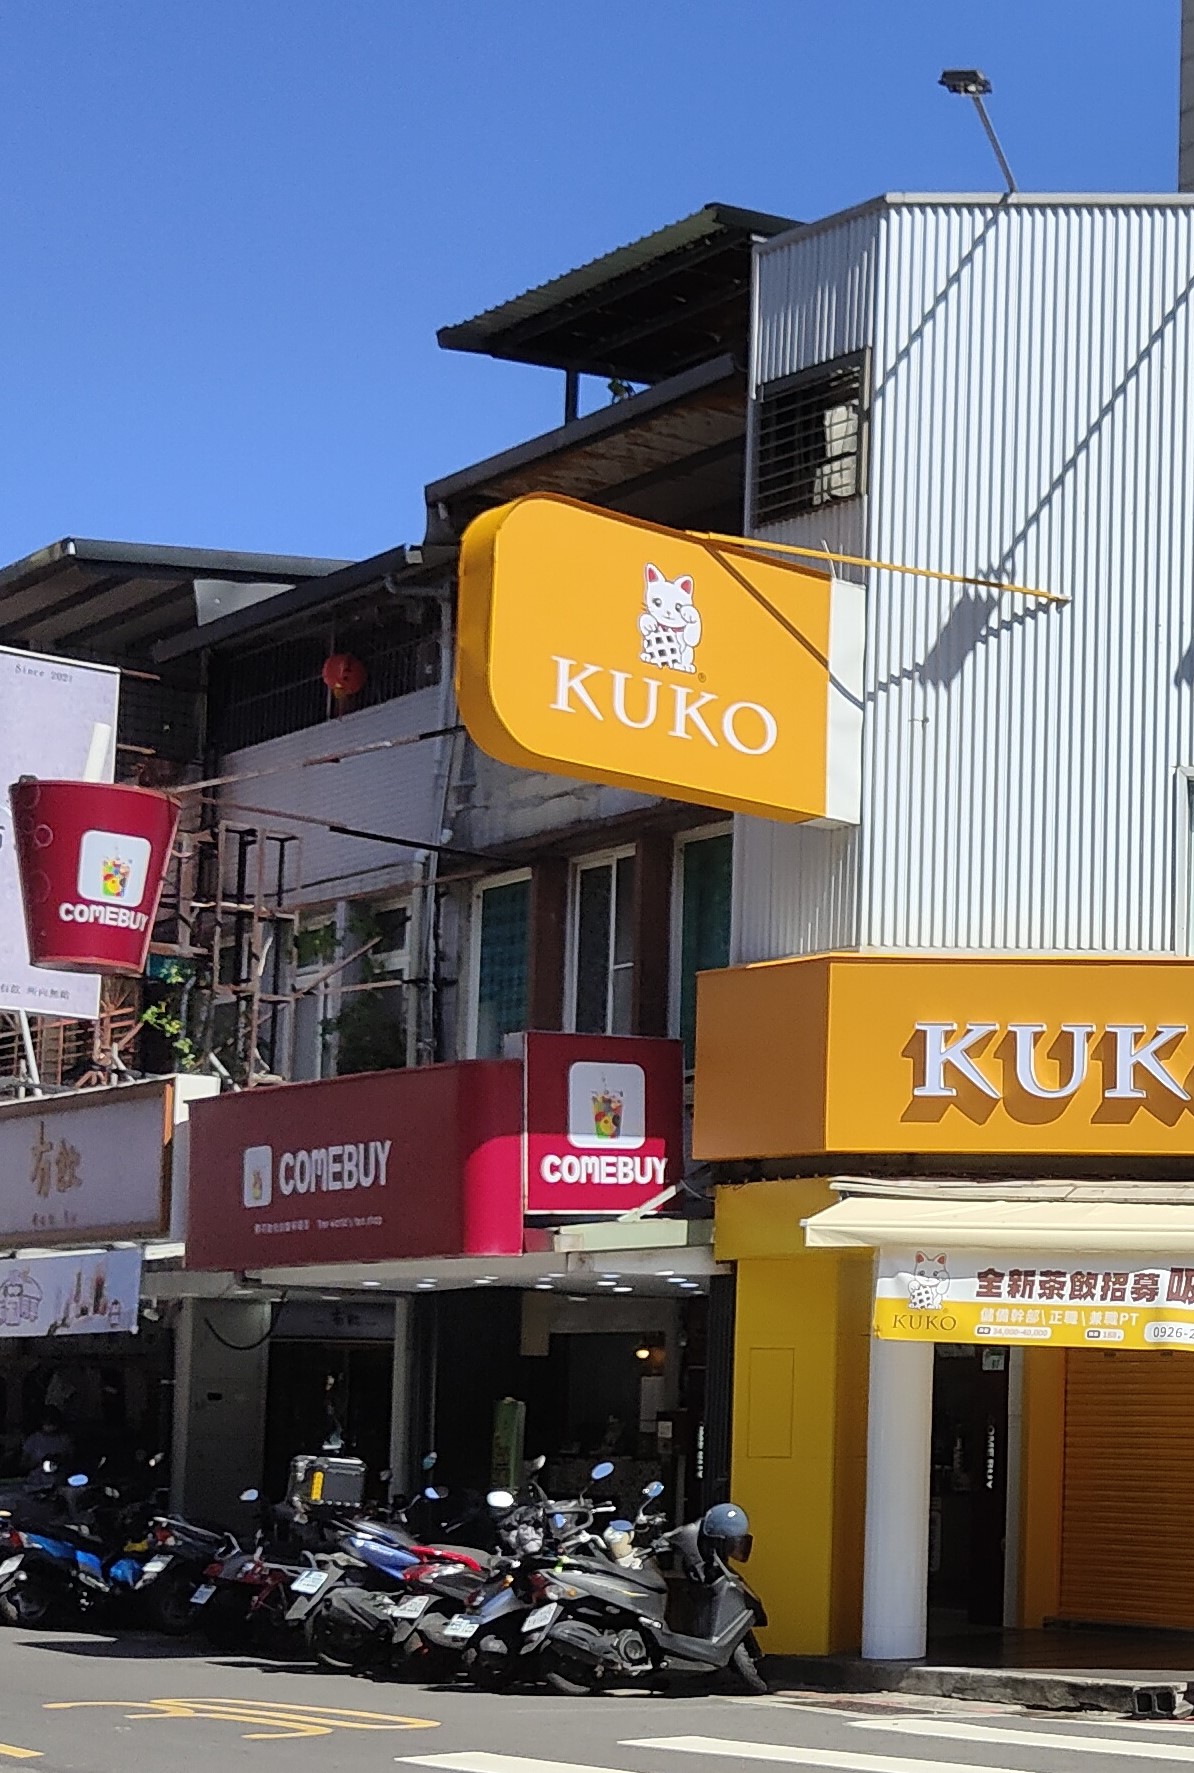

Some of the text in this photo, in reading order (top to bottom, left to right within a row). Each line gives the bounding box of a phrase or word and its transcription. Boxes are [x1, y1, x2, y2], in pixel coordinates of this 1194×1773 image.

[549, 655, 778, 756] KUKO
[59, 902, 150, 932] COMEBUY
[279, 1140, 392, 1195] COMEBUY
[540, 1154, 668, 1185] COMEBUY
[976, 1268, 1160, 1303] 全新茶飲招募
[892, 1314, 957, 1331] KUKO
